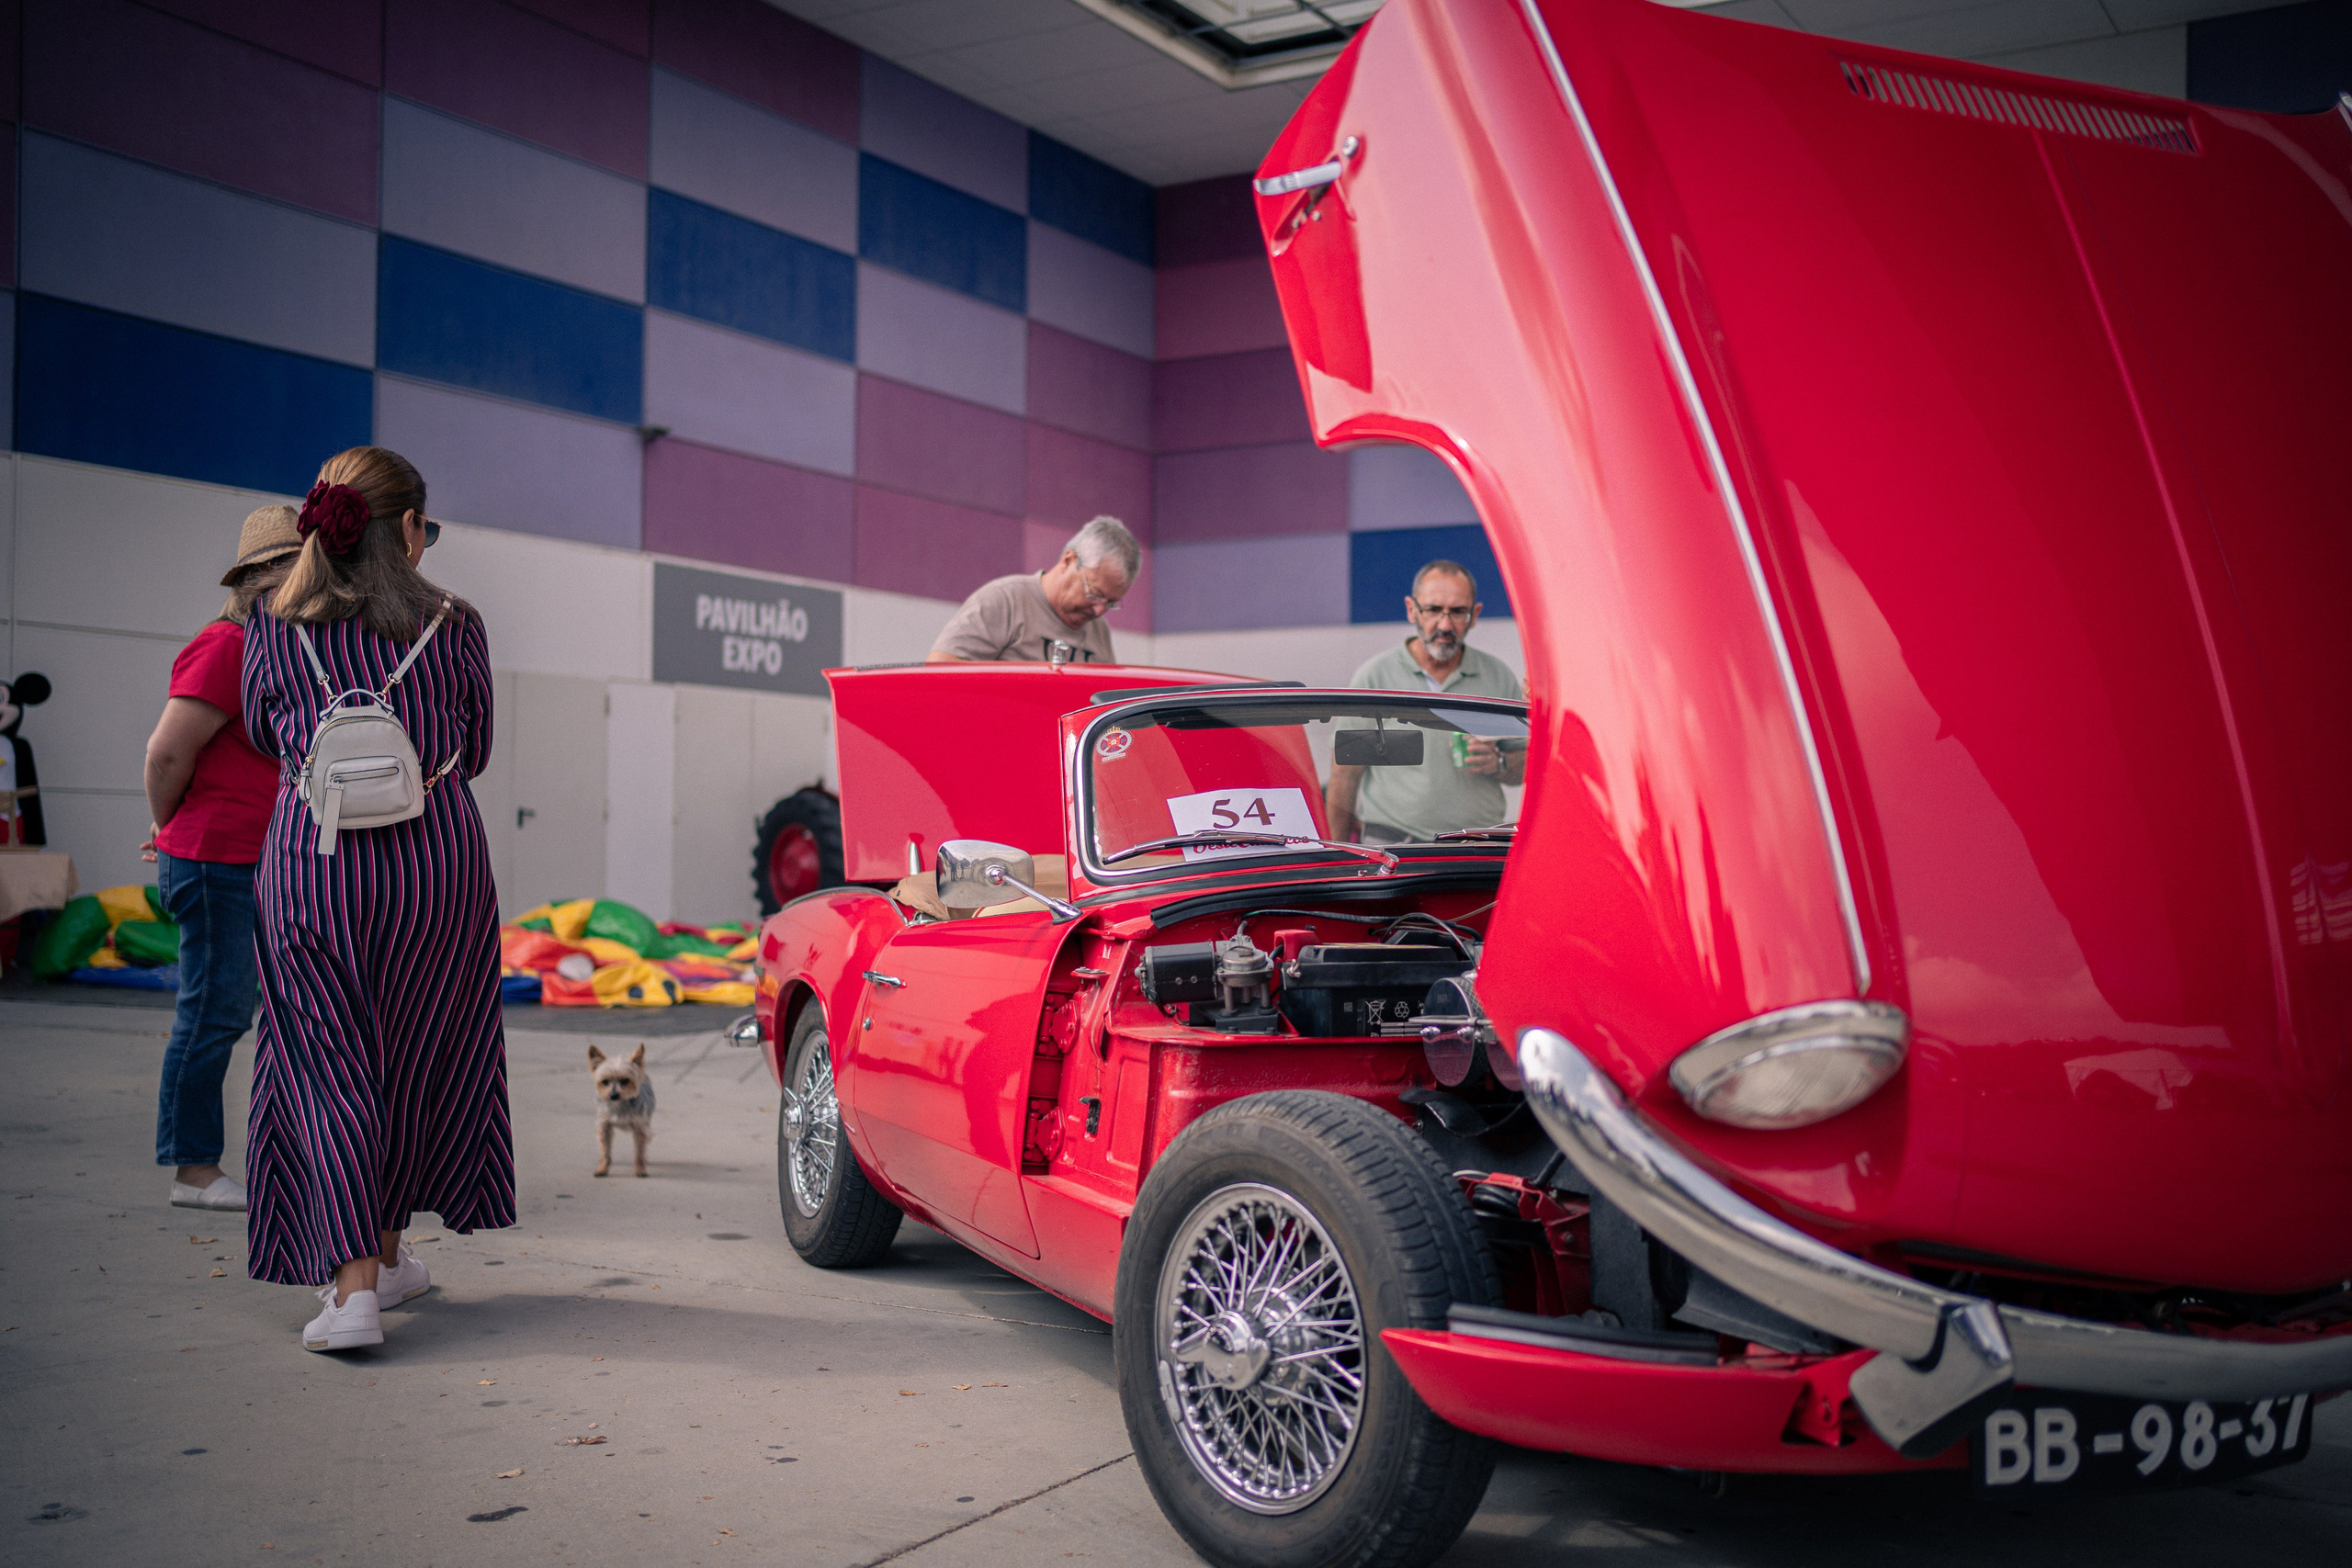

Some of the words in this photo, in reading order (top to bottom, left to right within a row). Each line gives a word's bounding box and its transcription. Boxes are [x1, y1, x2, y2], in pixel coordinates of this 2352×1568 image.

[697, 594, 808, 642] PAVILHÃO
[723, 637, 782, 675] EXPO
[1212, 797, 1275, 829] 54
[1985, 1393, 2309, 1486] BB-98-37
